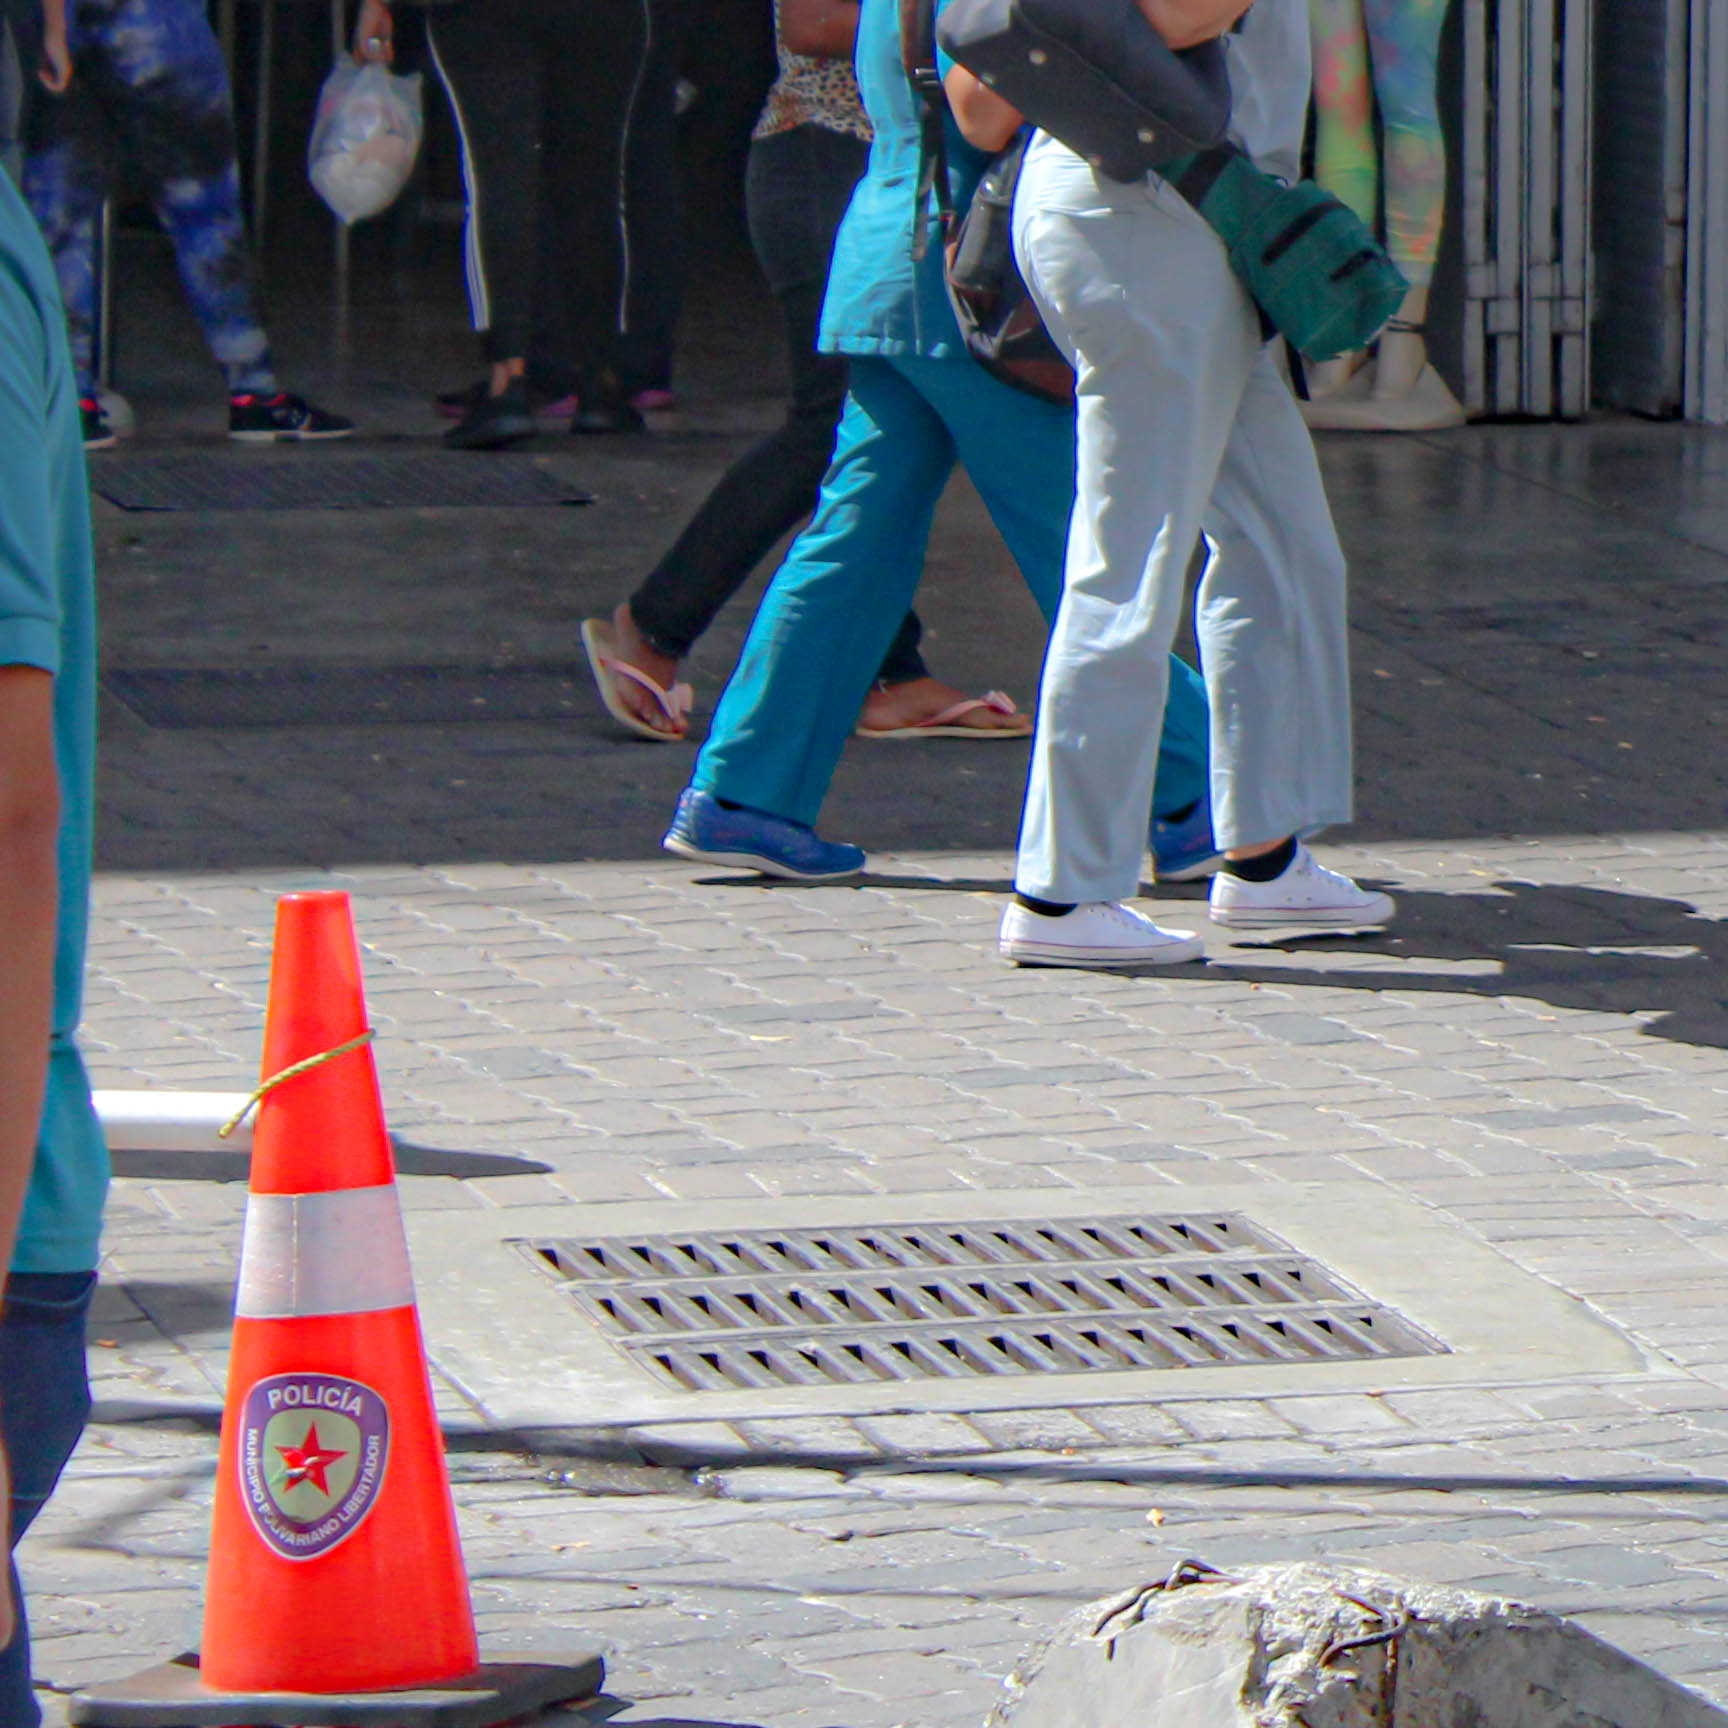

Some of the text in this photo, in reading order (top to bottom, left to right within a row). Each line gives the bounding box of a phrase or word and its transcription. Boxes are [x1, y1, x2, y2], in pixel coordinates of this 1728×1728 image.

[267, 1384, 364, 1417] POLICÍA
[245, 1427, 266, 1504] MUNICIPIO
[337, 1434, 381, 1522] LIBERTADOR
